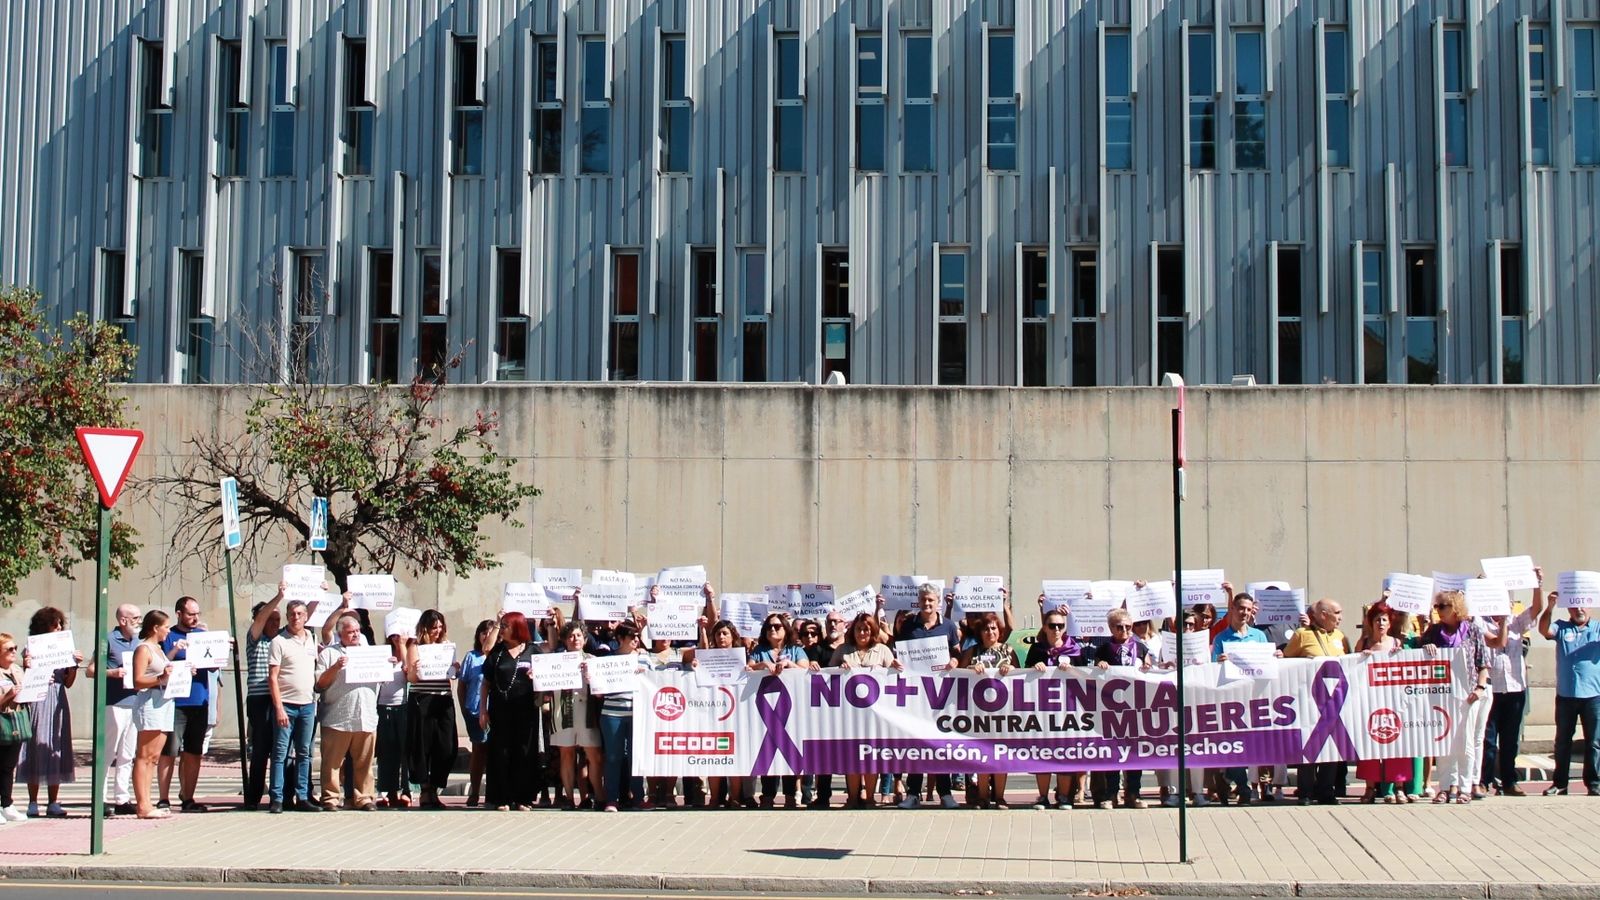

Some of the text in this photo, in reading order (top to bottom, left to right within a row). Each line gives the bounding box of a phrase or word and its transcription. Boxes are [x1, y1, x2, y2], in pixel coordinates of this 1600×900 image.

[1140, 608, 1156, 617] UGT
[1398, 601, 1414, 610] UGT
[1374, 666, 1432, 682] CCOO
[1405, 686, 1452, 695] Granada
[657, 692, 683, 706] UGT
[936, 714, 1094, 734] CONTRA LAS
[1101, 696, 1297, 740] MUJERES
[1404, 720, 1442, 728] GRANADA
[658, 736, 716, 750] CCOO
[859, 738, 1244, 763] Prevención, Protección y Derechos
[688, 756, 734, 766] Granada
